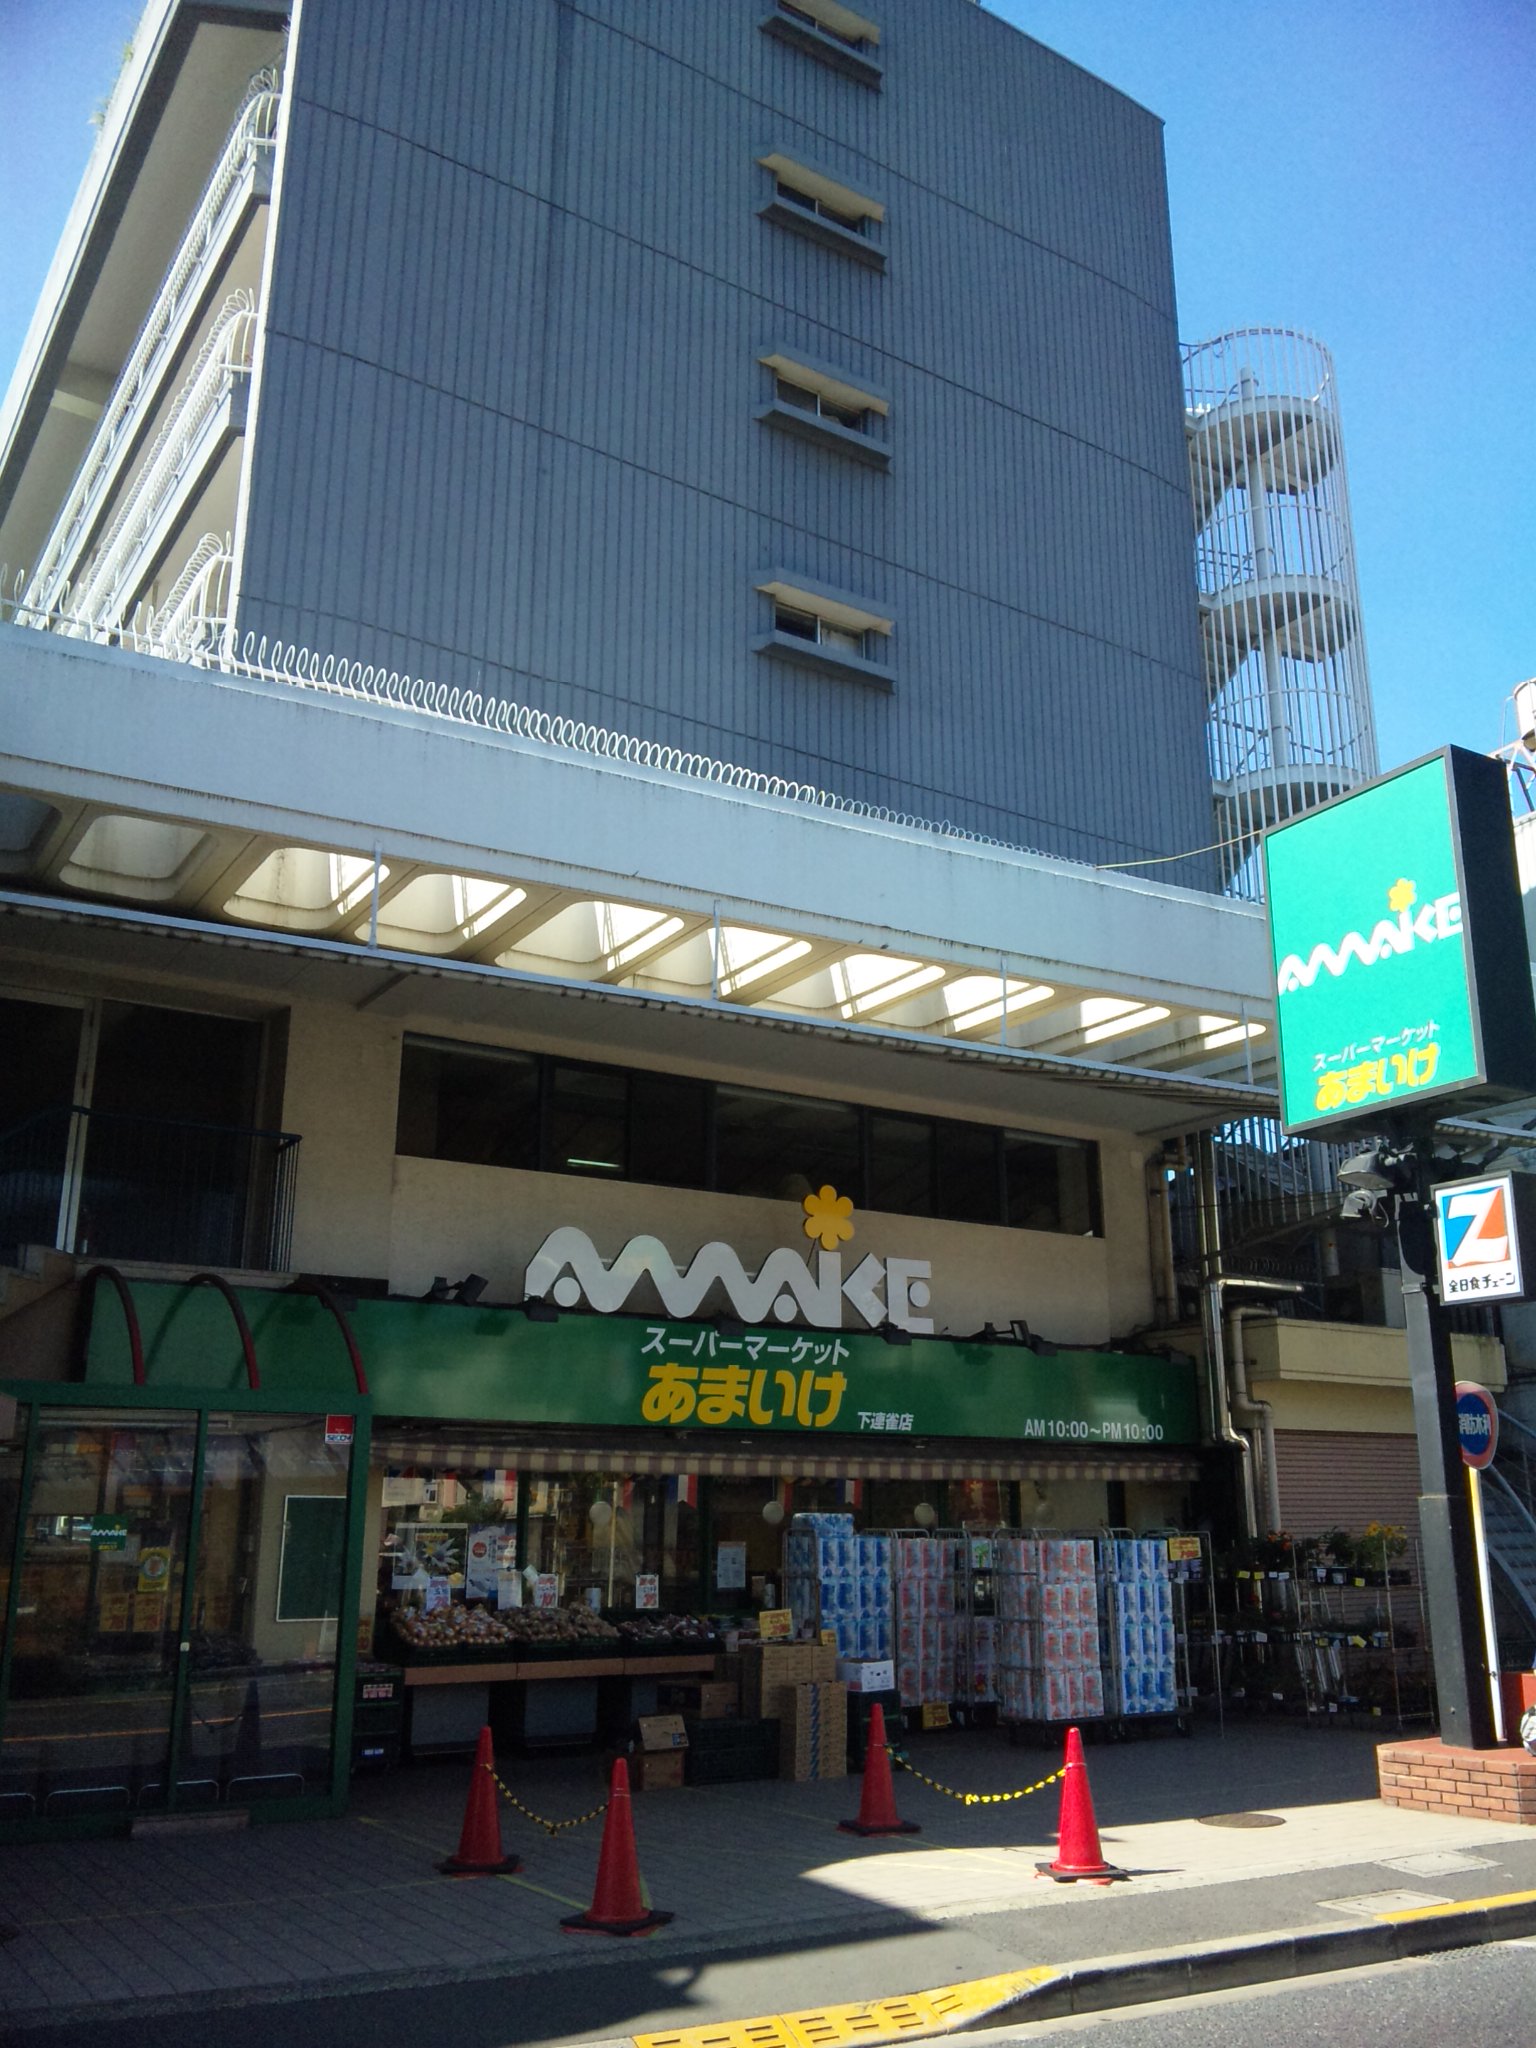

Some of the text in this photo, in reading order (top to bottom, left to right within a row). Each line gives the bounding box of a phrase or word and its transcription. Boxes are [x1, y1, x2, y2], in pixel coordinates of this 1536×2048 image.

[1315, 1042, 1440, 1112] あまいけ
[1449, 1272, 1516, 1294] 全日食チェーン
[640, 1326, 850, 1366] スーパーマーケット
[640, 1362, 848, 1429] あまいけ
[857, 1411, 914, 1432] 下連雀店
